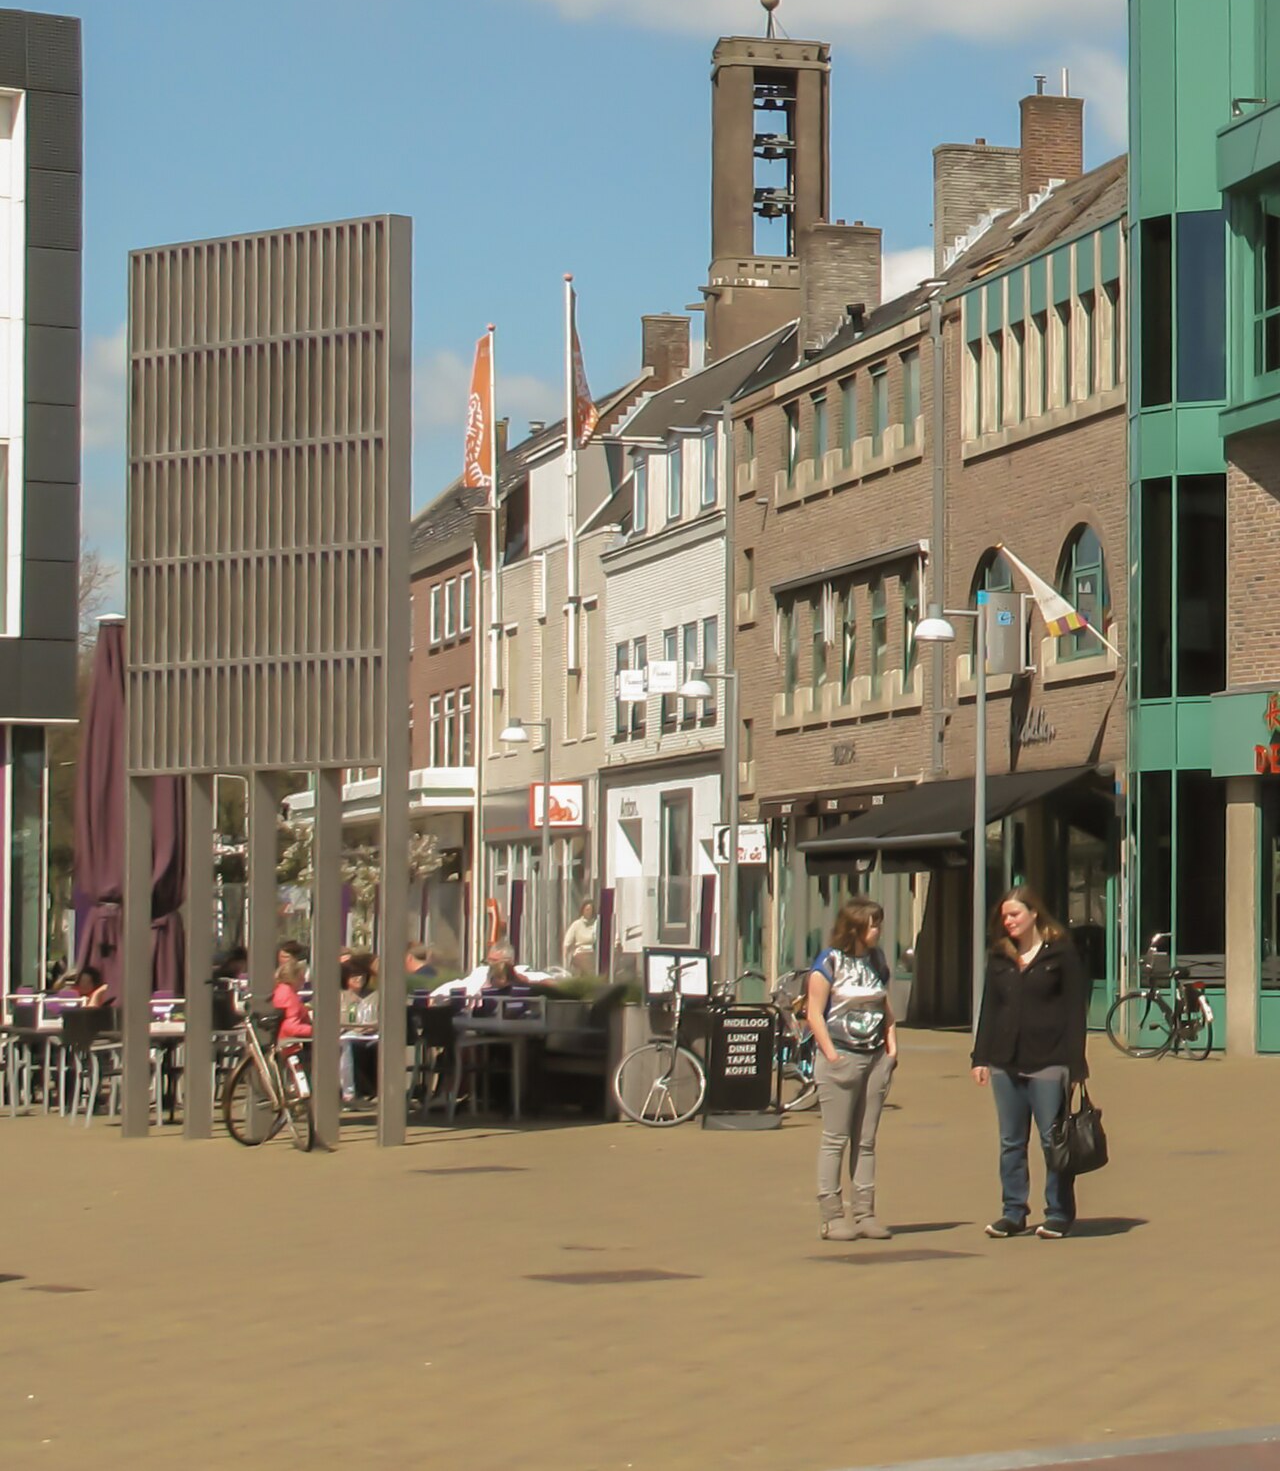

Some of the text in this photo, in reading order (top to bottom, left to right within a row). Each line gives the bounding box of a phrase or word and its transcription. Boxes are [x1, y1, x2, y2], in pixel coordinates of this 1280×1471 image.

[727, 1033, 759, 1042] LUNCH
[728, 1044, 756, 1053] DINER
[727, 1055, 756, 1064] TAPAS
[725, 1065, 757, 1076] KOFFIE
